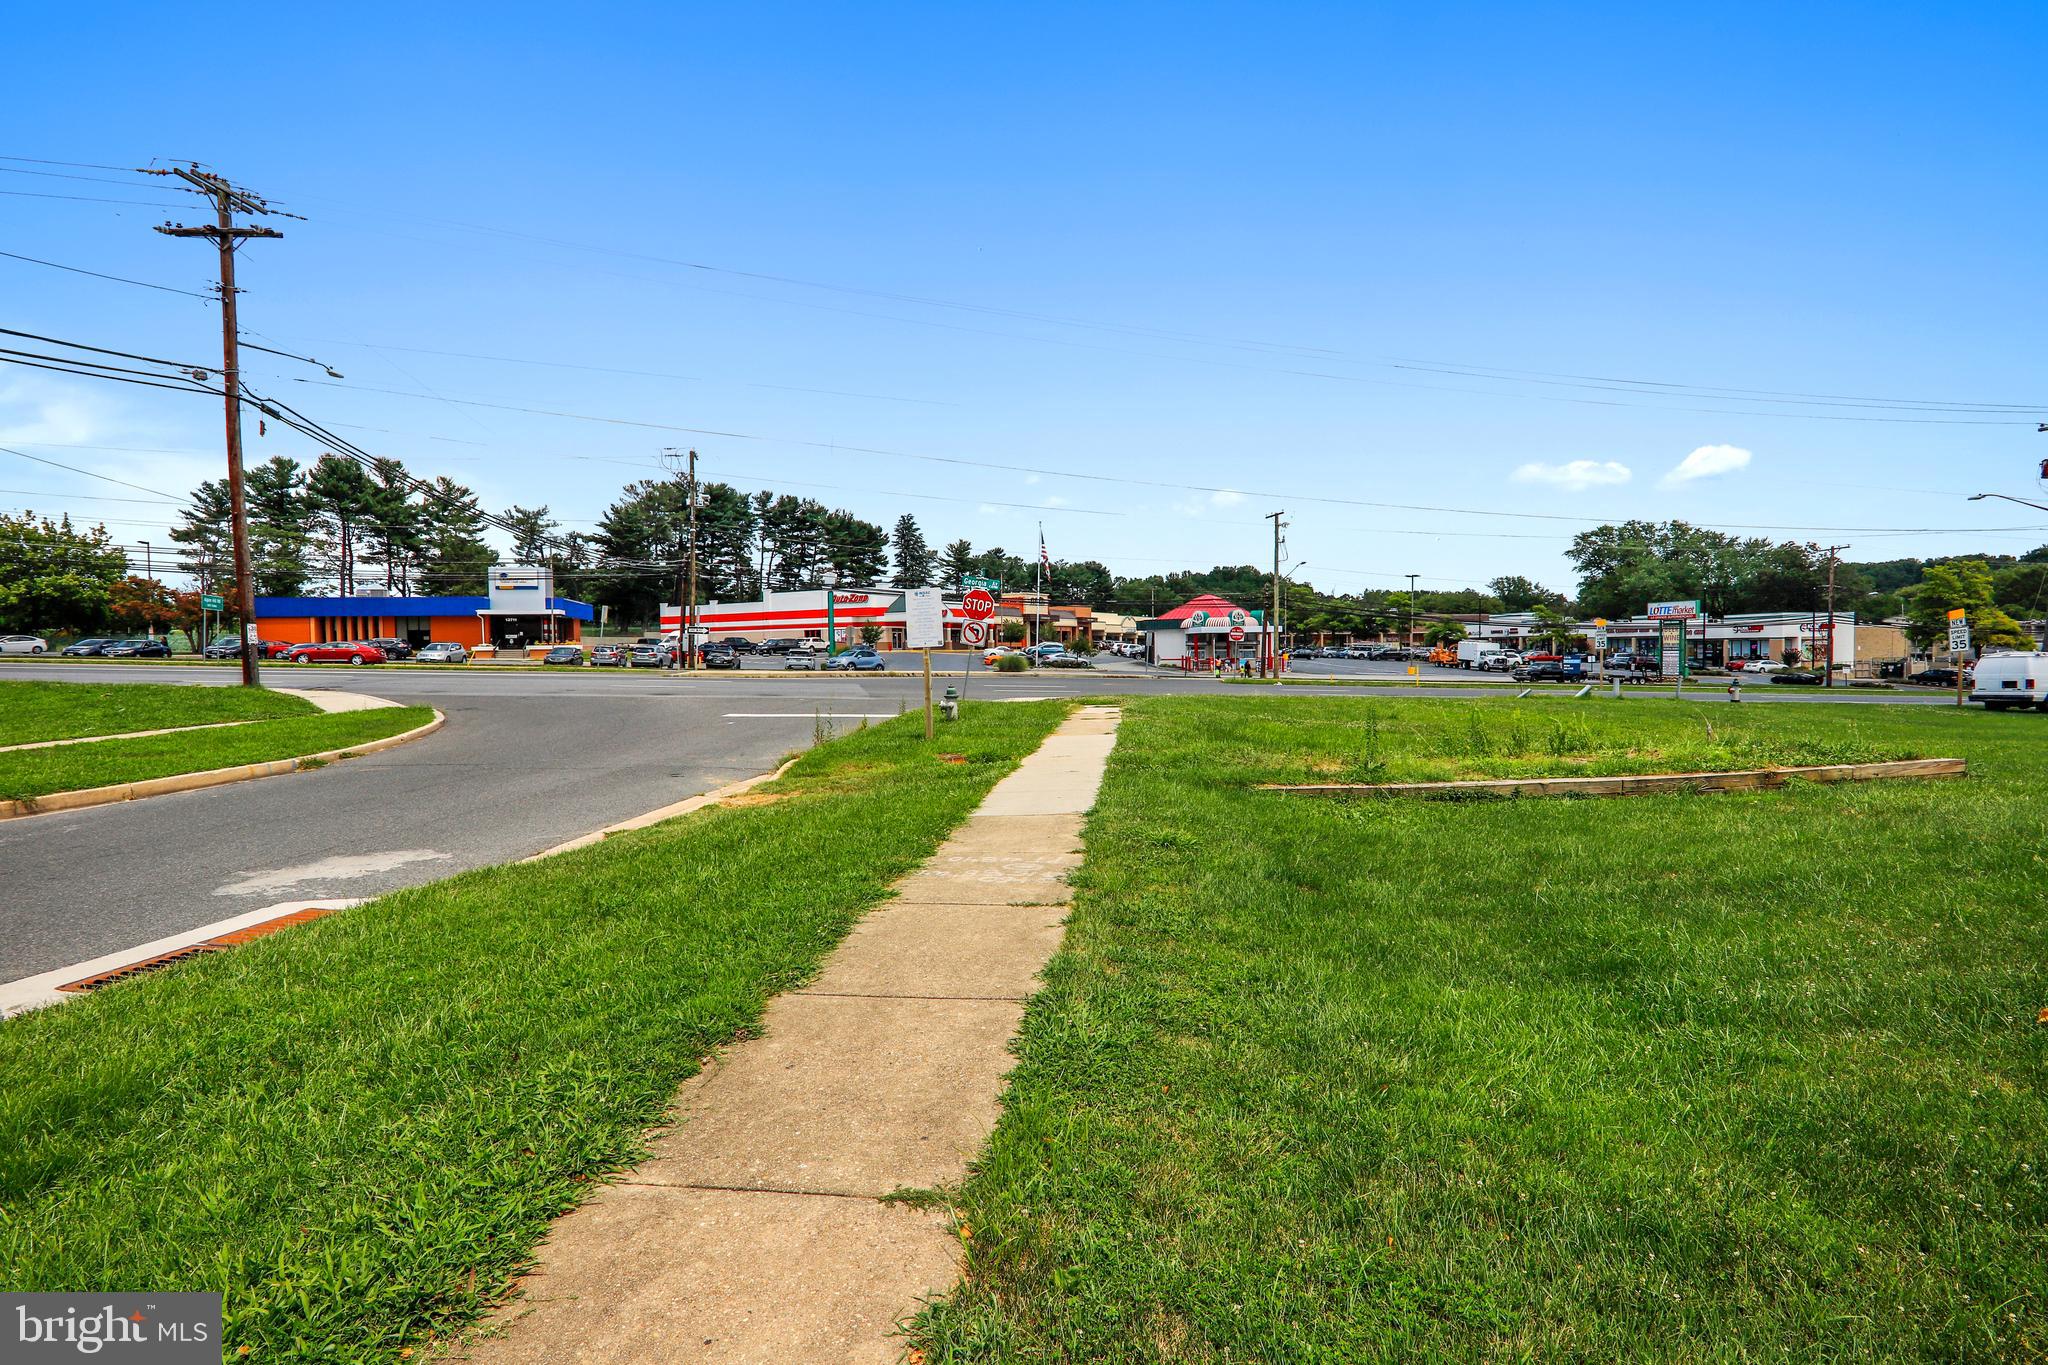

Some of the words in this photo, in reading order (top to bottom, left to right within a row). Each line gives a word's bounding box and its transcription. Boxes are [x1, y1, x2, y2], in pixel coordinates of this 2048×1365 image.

[963, 577, 987, 587] Georgia
[965, 598, 992, 612] STOP
[1649, 606, 1672, 615] LOTTE
[1672, 605, 1695, 614] market
[1596, 640, 1606, 648] 35
[1951, 640, 1967, 650] 35
